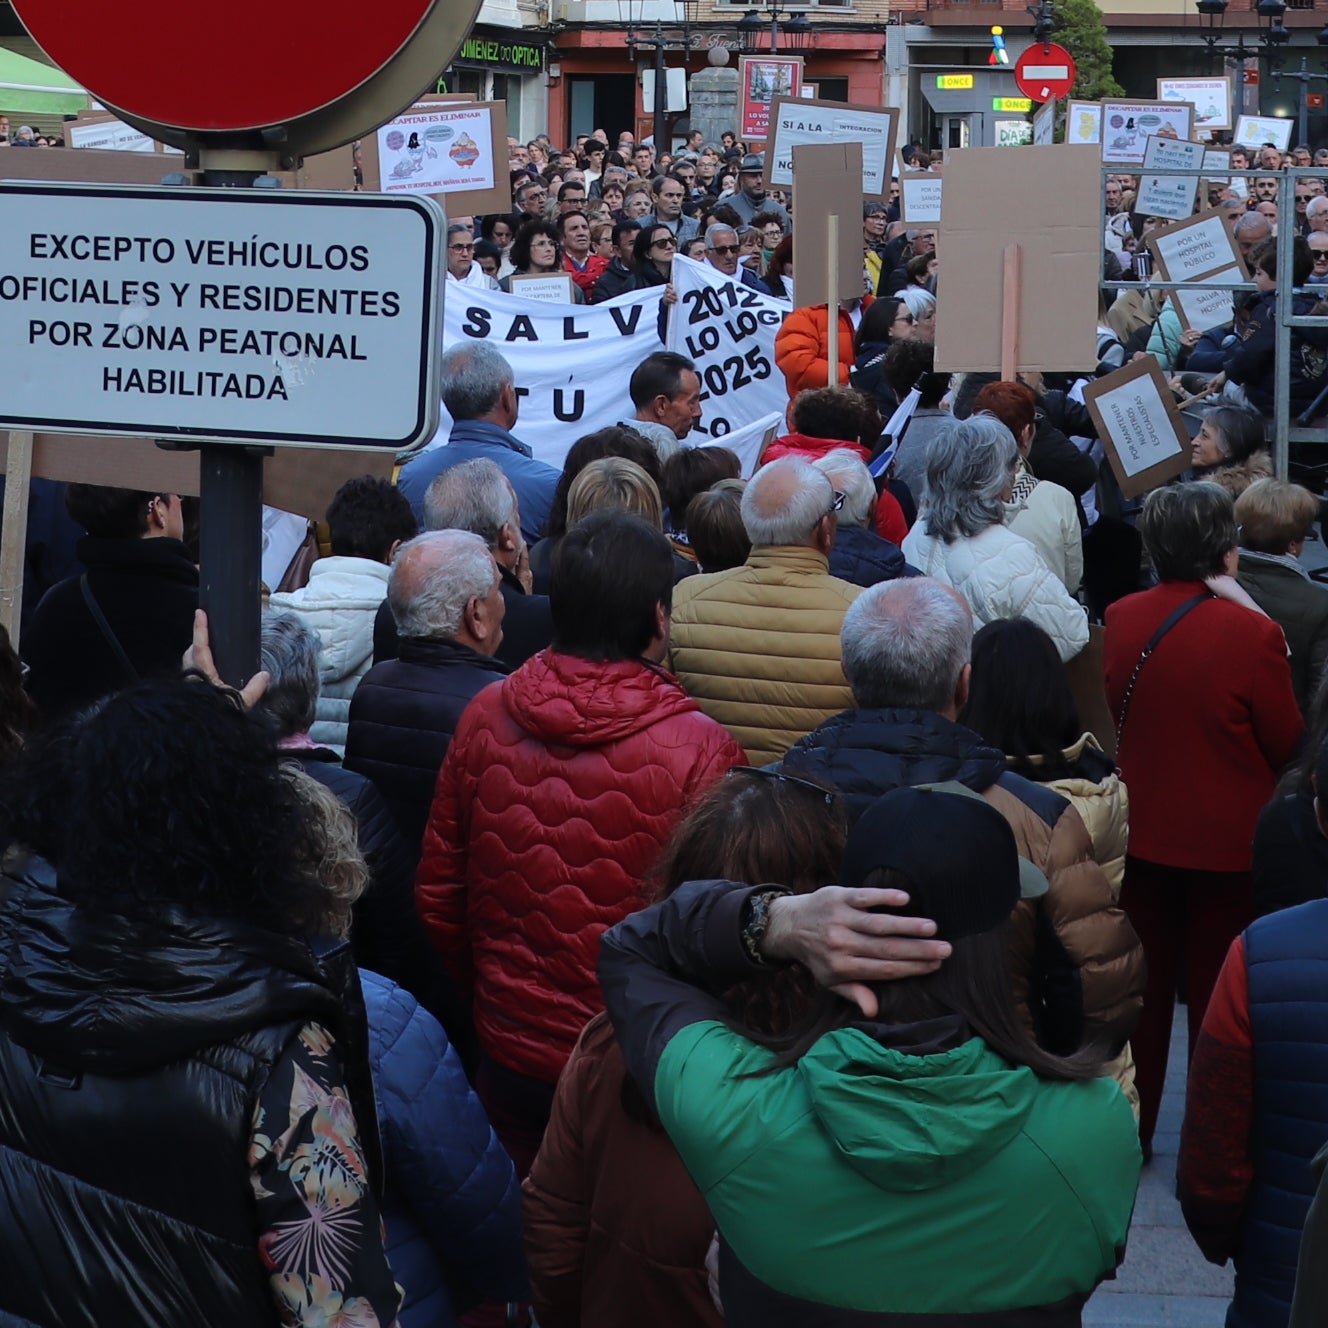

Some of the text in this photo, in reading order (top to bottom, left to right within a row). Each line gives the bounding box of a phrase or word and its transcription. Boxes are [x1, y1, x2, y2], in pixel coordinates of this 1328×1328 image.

[460, 39, 540, 67] JIMENEZ OPTICA
[947, 78, 969, 86] ONCE
[440, 112, 481, 121] ELIMINAR
[1005, 100, 1032, 109] ONCE
[782, 120, 882, 134] SI A LA INTEGRACION
[1154, 157, 1183, 167] HOSPITAL
[30, 233, 370, 272] EXCEPTO VEHÍCULOS
[1177, 231, 1207, 247] POR UN
[1178, 241, 1214, 258] HOSPITAL
[1184, 251, 1216, 268] PÚBLICO
[170, 282, 190, 308] Y
[200, 283, 401, 318] RESIDENTES
[682, 281, 764, 326] 2012
[1196, 290, 1220, 304] SALVA
[29, 320, 368, 361] POR ZONA PEATONAL
[685, 326, 720, 359] LO
[102, 366, 289, 402] HABILITADA
[1110, 402, 1140, 461] POR MANTENER
[1126, 407, 1147, 446] NUESTROS
[1134, 395, 1161, 447] ESPECIALISTAS
